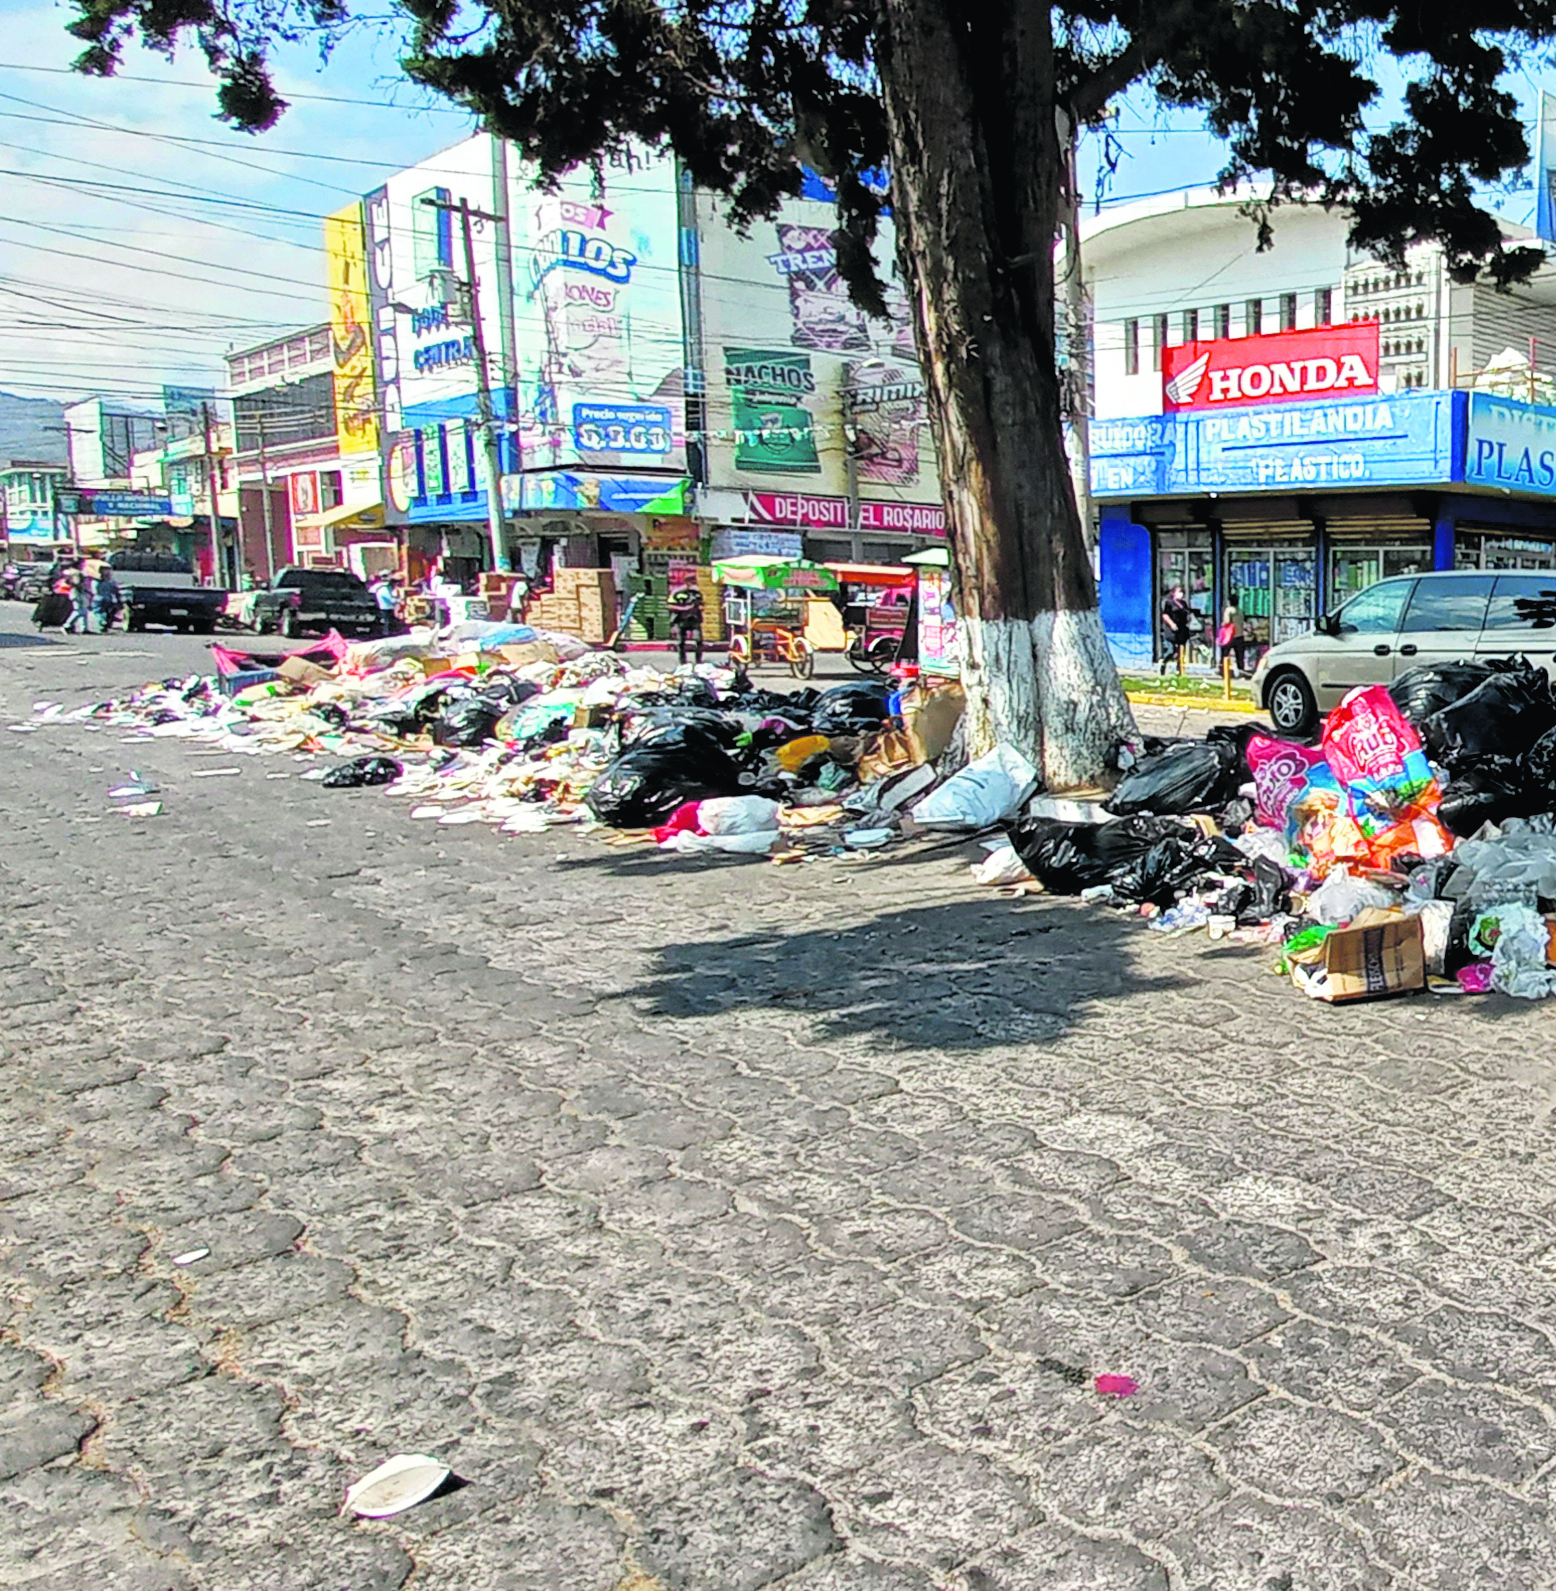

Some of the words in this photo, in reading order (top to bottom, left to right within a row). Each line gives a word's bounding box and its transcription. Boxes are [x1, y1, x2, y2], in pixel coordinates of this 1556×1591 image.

[725, 365, 816, 392] NACHOS
[1207, 354, 1374, 402] HONDA
[1205, 402, 1394, 442] PLASTILANDIA
[860, 505, 881, 525] EL
[882, 507, 945, 529] ROSARIO
